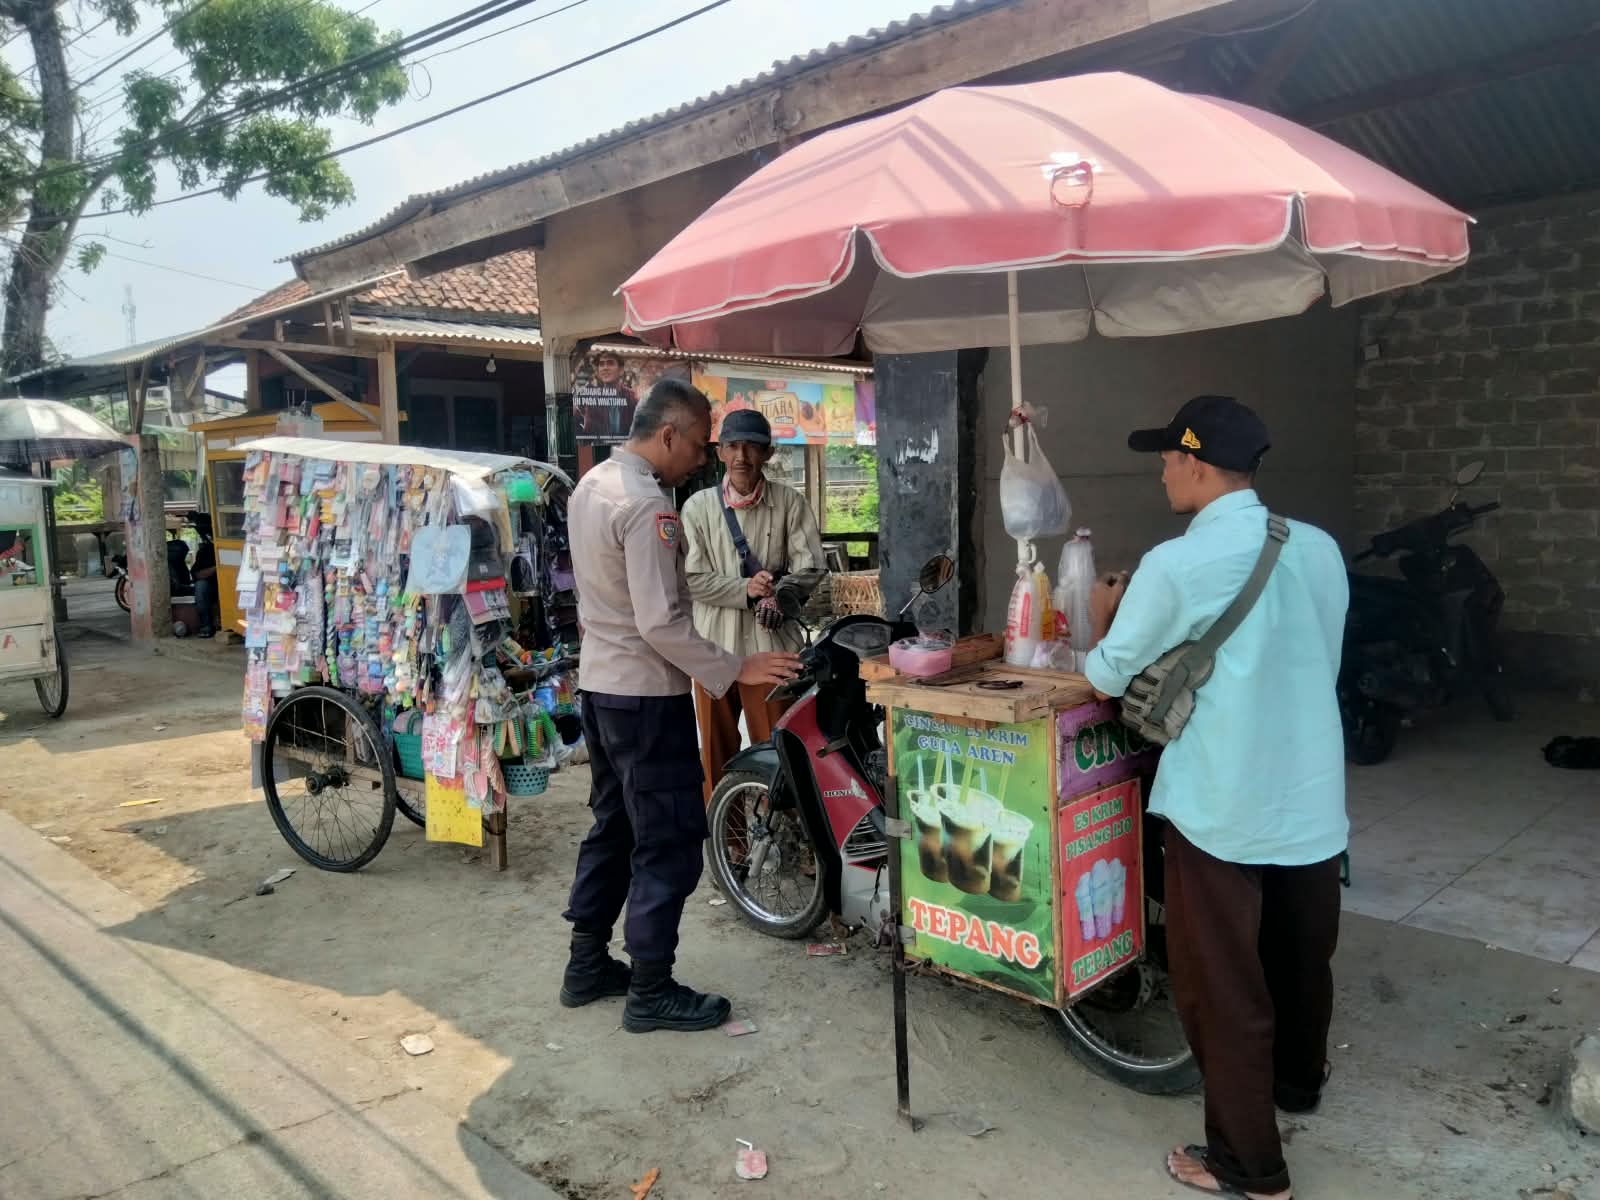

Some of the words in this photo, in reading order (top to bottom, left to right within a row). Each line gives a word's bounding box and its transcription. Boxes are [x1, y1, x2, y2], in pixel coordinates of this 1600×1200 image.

[602, 387, 617, 396] AKAN
[917, 735, 961, 755] GULA
[967, 744, 1016, 765] AREN
[986, 727, 1029, 747] KRIM
[1073, 810, 1089, 832] ES
[1091, 797, 1123, 825] KRIM
[1065, 825, 1111, 861] PISANG
[908, 896, 1042, 969] TEPANG
[1072, 929, 1132, 986] TEPANG
